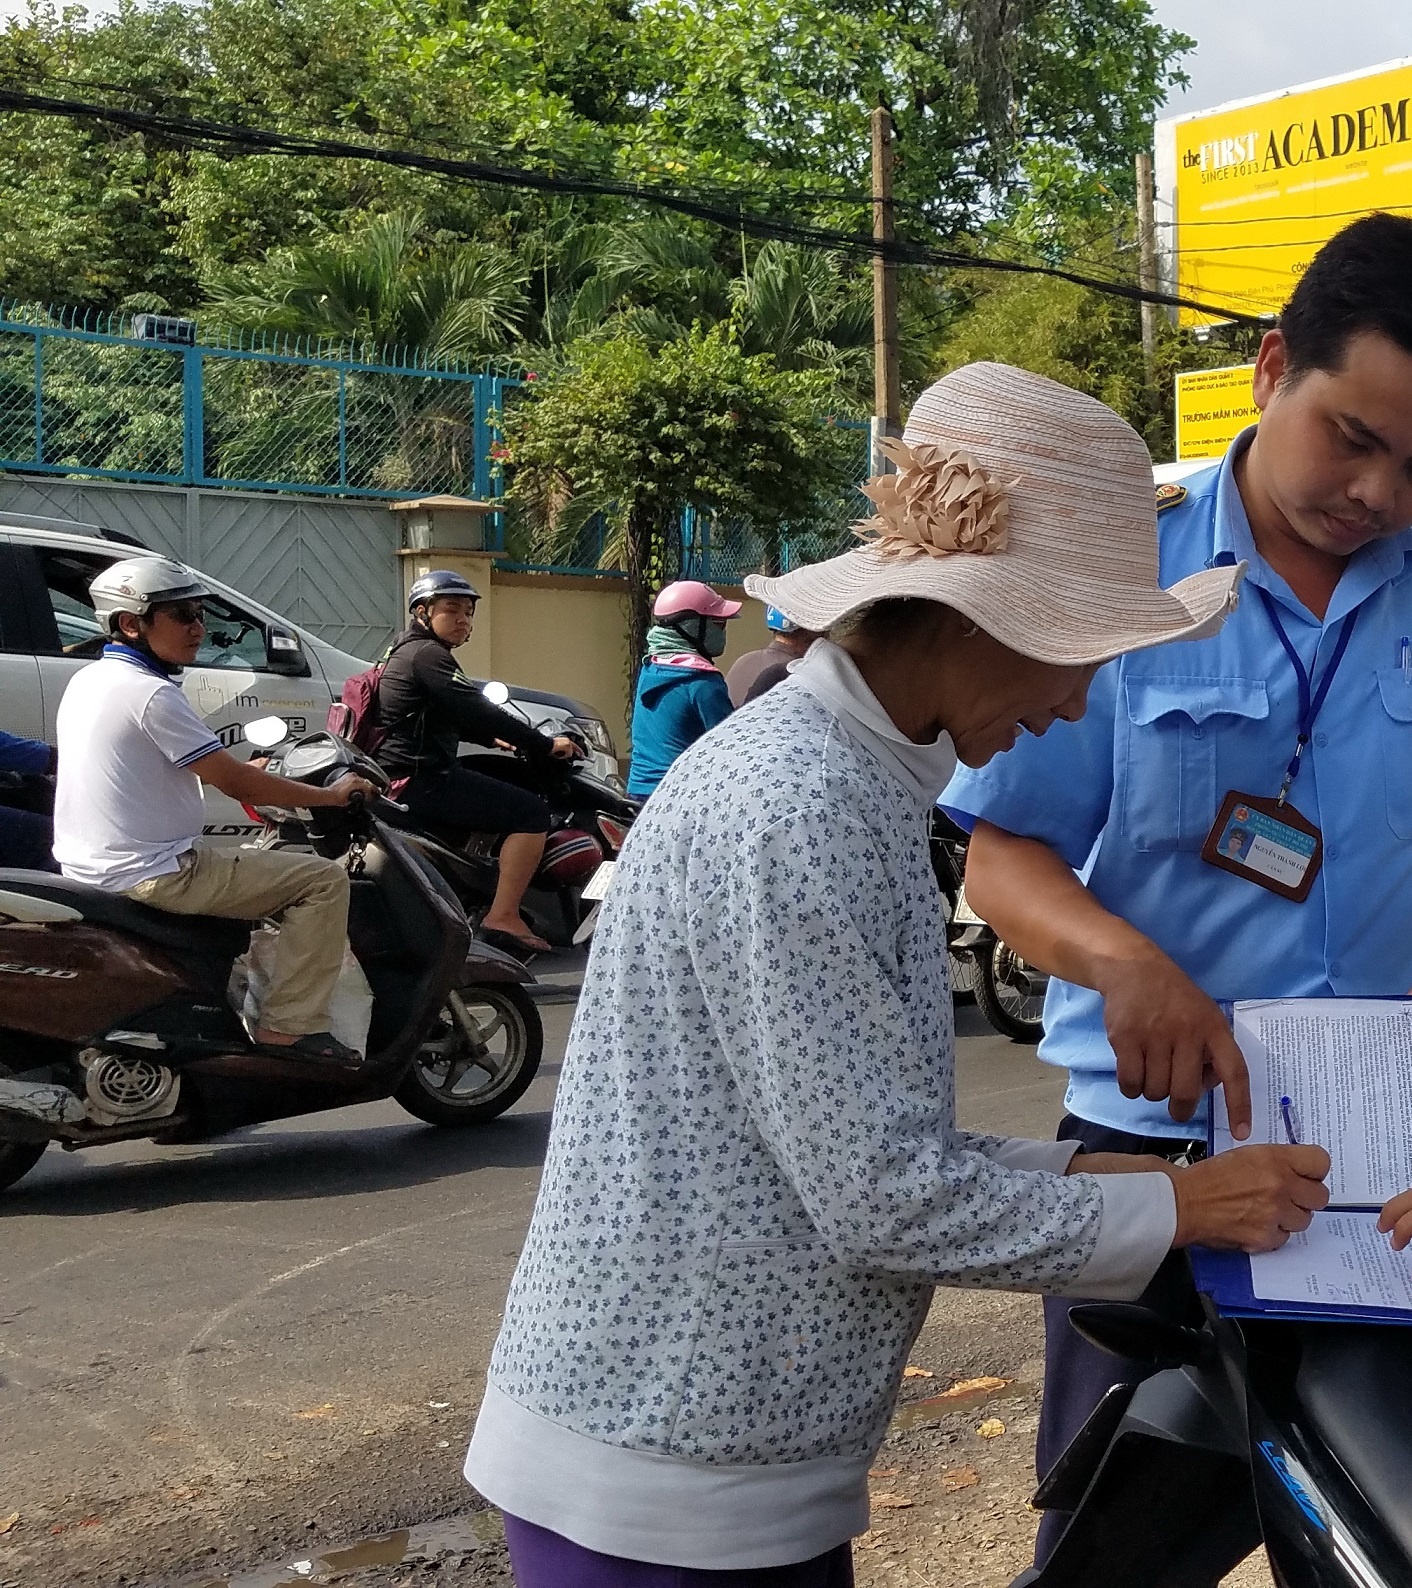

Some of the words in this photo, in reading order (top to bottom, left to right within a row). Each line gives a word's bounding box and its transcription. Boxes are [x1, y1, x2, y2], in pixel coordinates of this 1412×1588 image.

[1183, 149, 1201, 169] the
[1200, 131, 1260, 172] FIRST
[1201, 168, 1229, 185] SINCE
[1233, 162, 1260, 179] 2013
[1182, 411, 1212, 423] TRƯỜNG
[1232, 407, 1248, 418] NON
[236, 692, 259, 708] im
